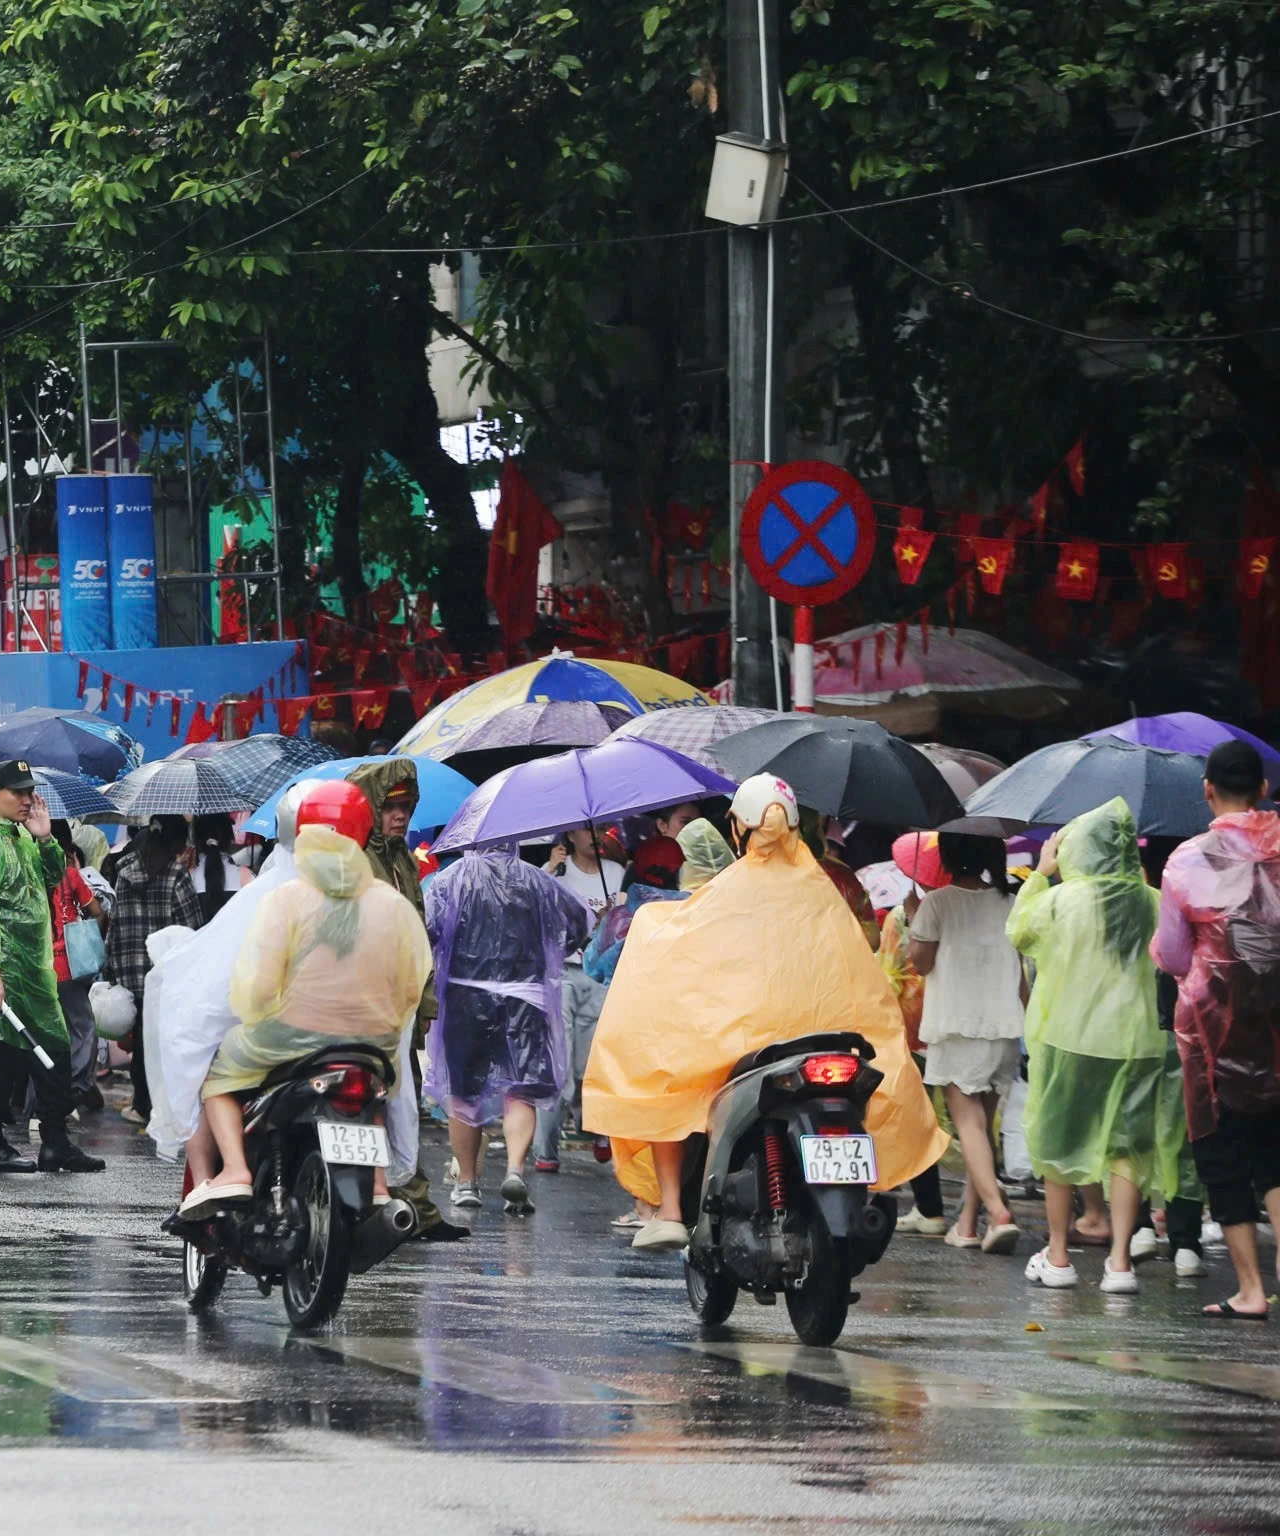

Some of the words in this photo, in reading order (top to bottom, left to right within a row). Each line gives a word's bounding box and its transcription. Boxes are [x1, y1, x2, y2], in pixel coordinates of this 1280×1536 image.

[126, 505, 152, 513] VNPT
[330, 1125, 377, 1145] 12-P1
[332, 1143, 381, 1163] 9552
[813, 1140, 863, 1159] 29-C2
[808, 1161, 871, 1181] 042.91
